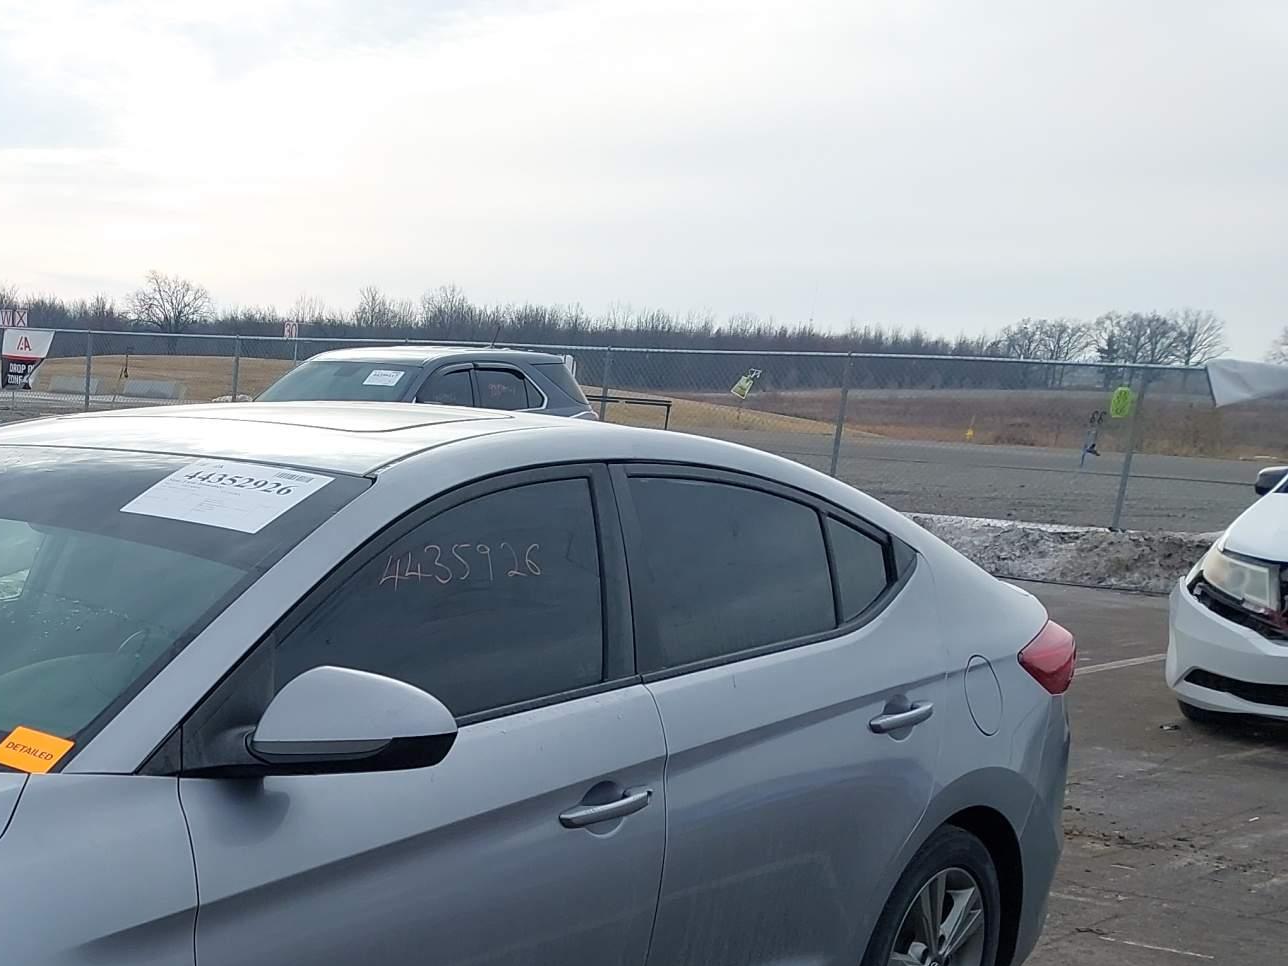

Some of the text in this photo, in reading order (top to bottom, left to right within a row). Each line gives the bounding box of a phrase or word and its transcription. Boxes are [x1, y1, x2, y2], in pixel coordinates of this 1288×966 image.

[1, 310, 27, 327] W X
[9, 363, 27, 373] DROP
[184, 470, 300, 496] 44352926
[379, 543, 542, 592] 4435926
[6, 741, 54, 761] DETAILED
